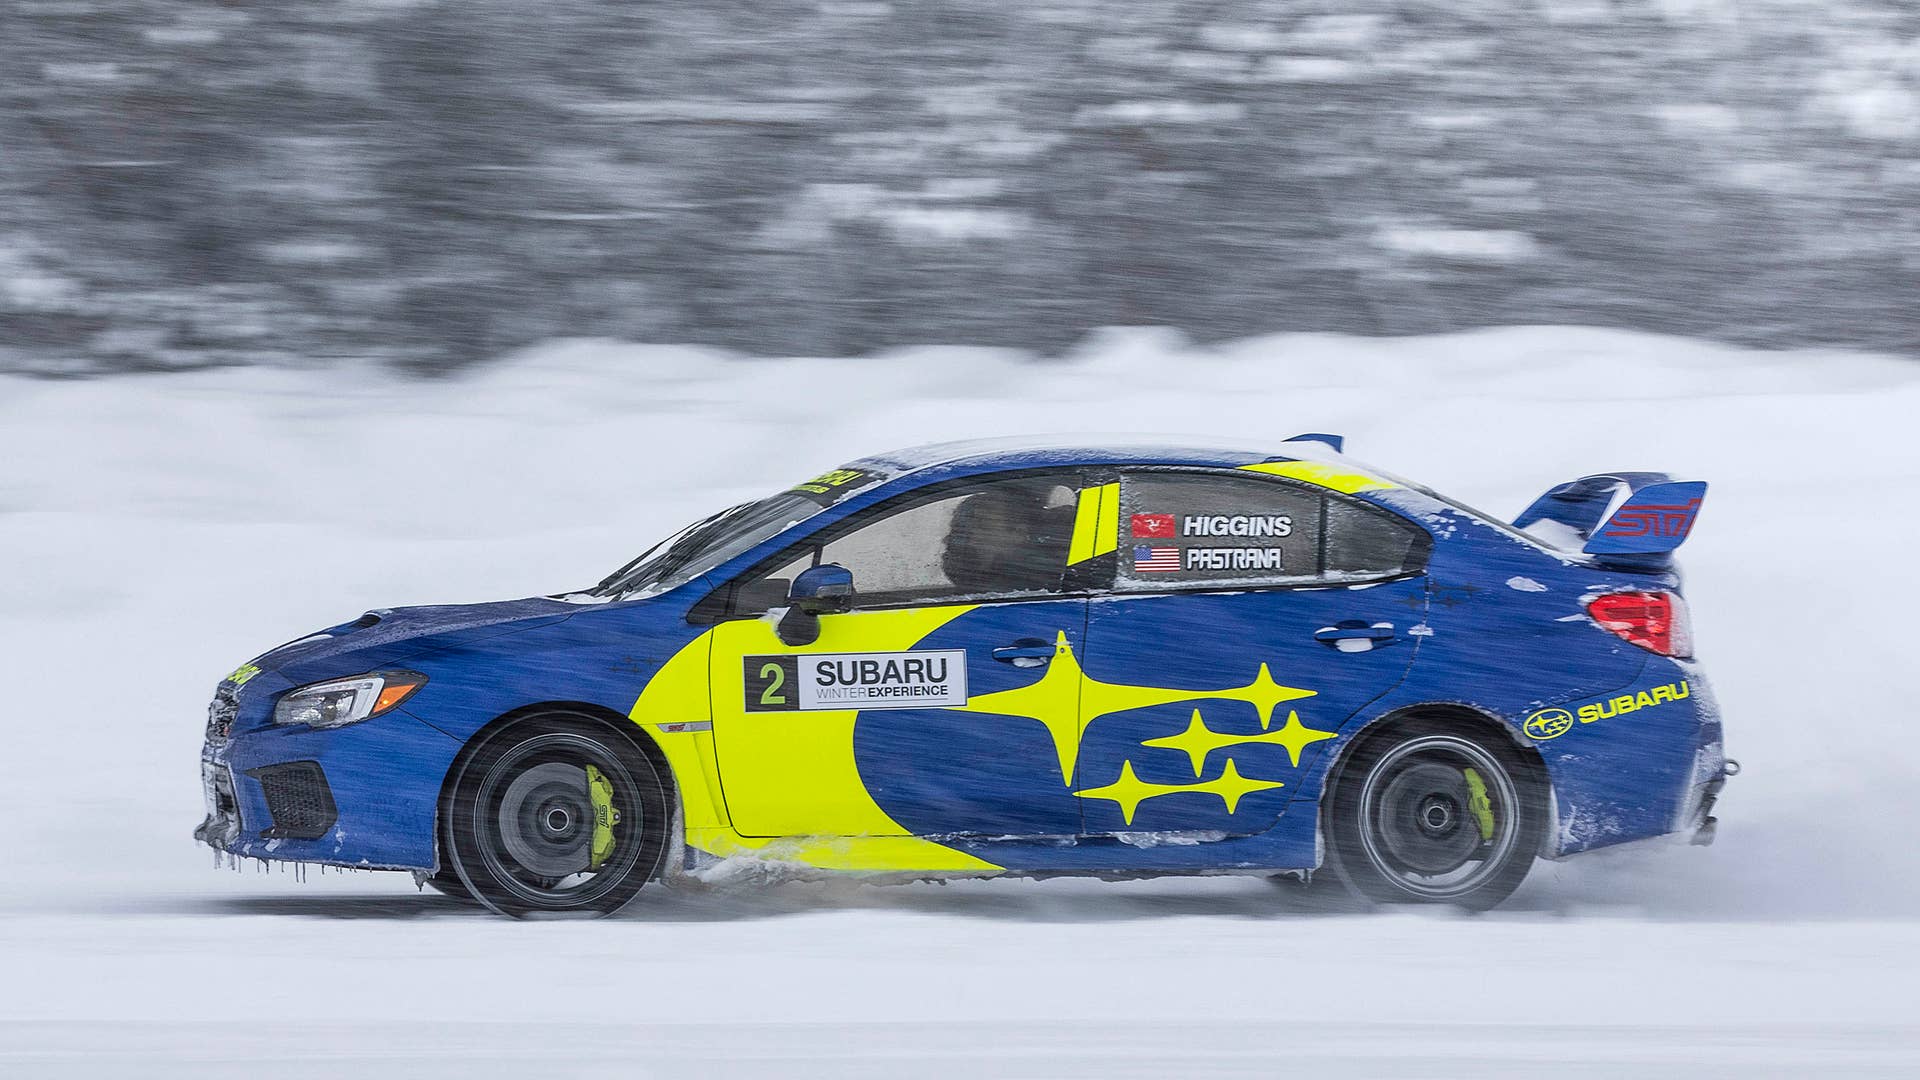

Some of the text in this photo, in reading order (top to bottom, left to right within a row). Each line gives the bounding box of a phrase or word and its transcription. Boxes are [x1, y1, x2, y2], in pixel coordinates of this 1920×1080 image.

[1183, 515, 1292, 537] HIGGINS
[1186, 548, 1282, 570] PASTRANA
[759, 662, 786, 705] 2
[816, 658, 948, 686] SUBARU
[1577, 680, 1690, 724] SUBARU
